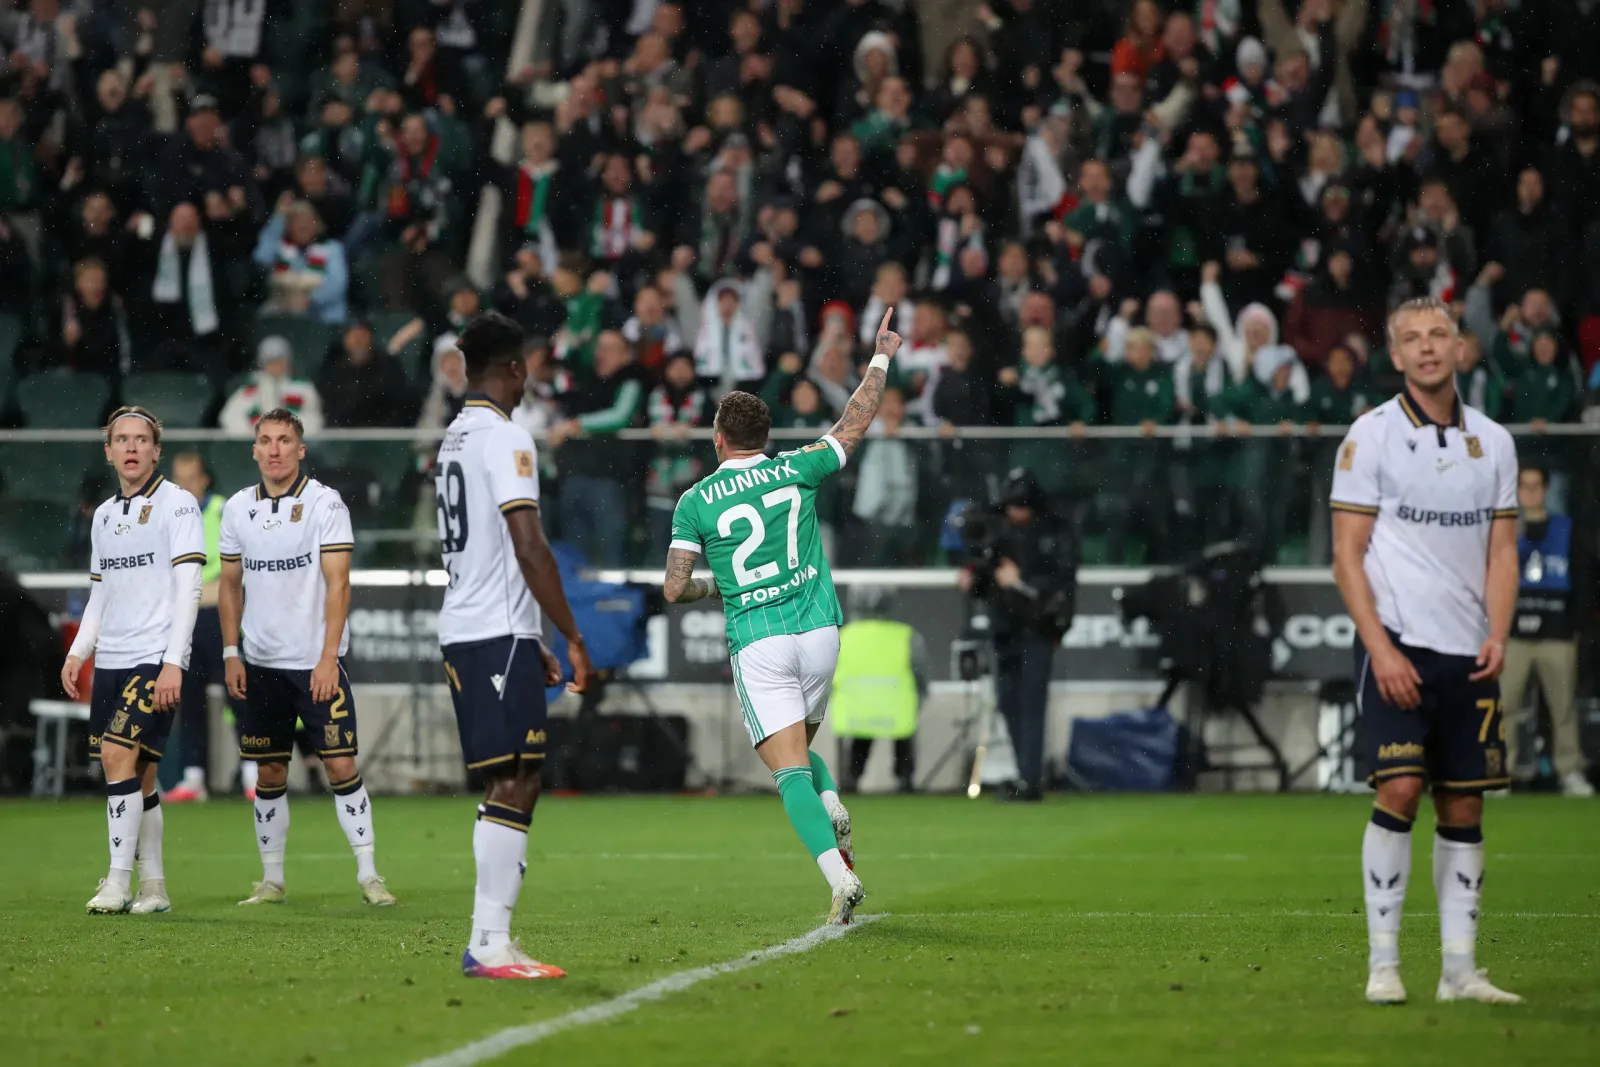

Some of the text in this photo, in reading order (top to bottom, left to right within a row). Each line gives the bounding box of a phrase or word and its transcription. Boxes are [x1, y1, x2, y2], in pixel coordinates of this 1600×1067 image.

[700, 460, 799, 505] VIUNNYK
[717, 484, 801, 587] 27
[244, 552, 313, 572] SUPERBET
